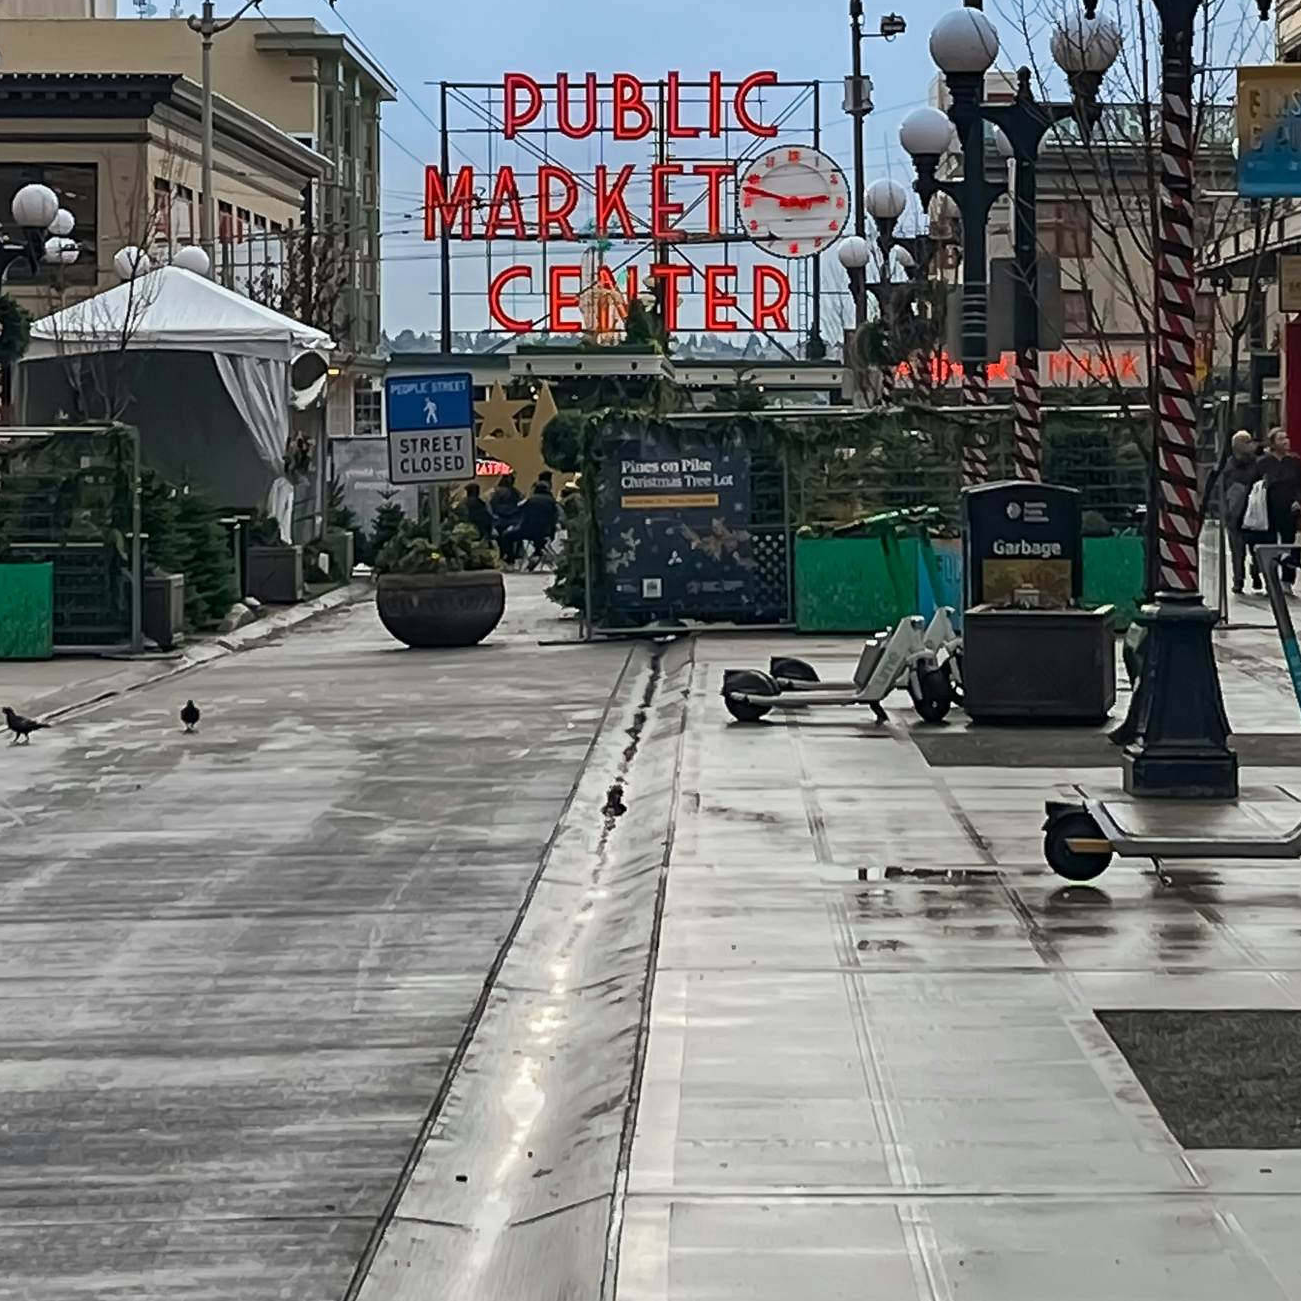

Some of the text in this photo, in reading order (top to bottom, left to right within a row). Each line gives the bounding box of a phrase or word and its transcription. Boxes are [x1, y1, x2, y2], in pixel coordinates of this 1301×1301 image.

[504, 71, 779, 140] PUBLIC
[424, 164, 736, 241] MARKET
[488, 265, 791, 333] CENTER
[390, 380, 468, 395] PEOPLE STREET
[400, 435, 464, 454] STREET
[400, 455, 464, 474] CLOSED
[621, 458, 712, 473] Pines on Pike
[621, 473, 734, 488] Christmas Tree Lot
[993, 539, 1061, 558] Garbage
